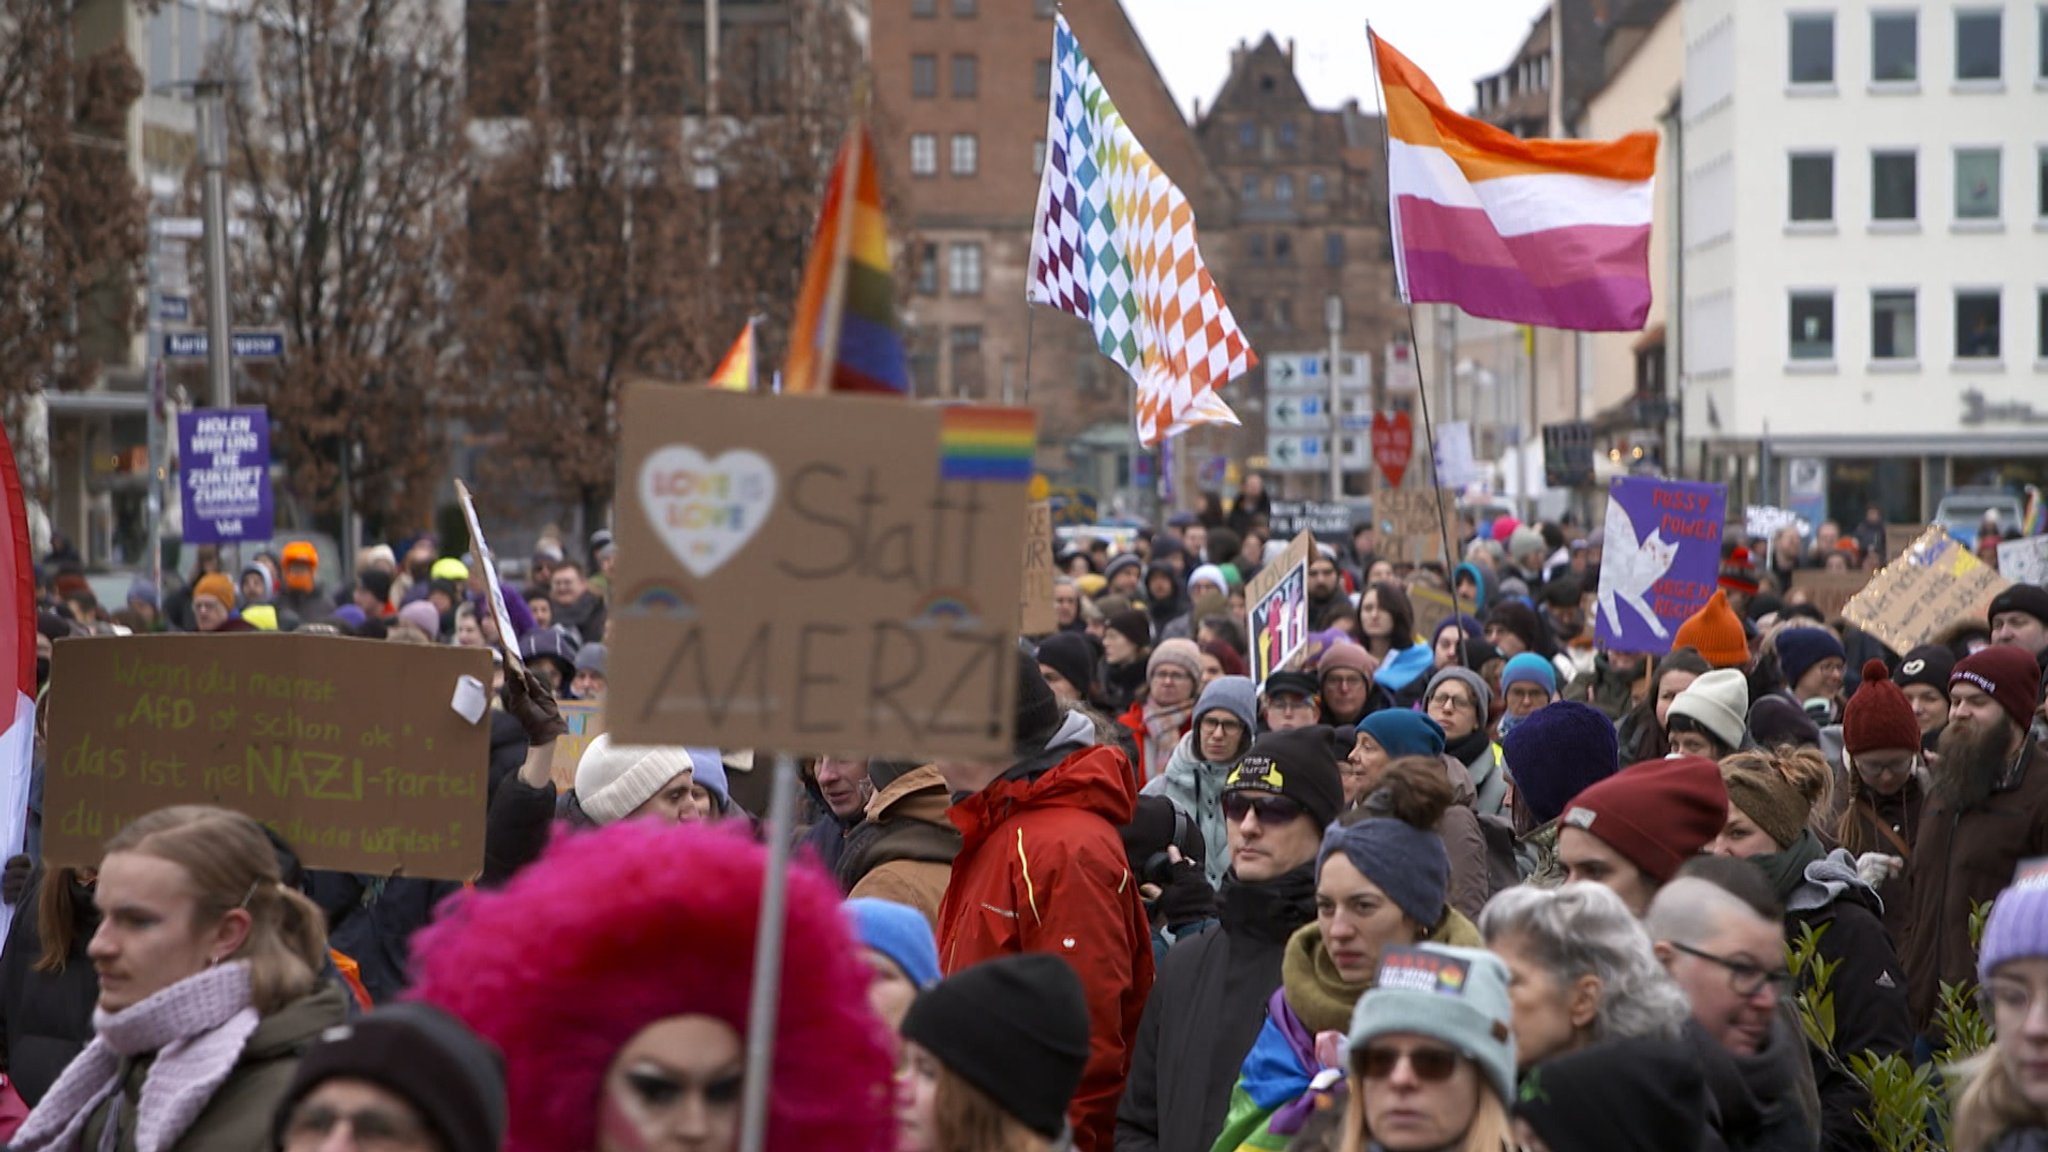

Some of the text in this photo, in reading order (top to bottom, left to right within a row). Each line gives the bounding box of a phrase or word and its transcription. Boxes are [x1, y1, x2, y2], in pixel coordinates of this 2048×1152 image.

[197, 416, 251, 434] HOLEN
[191, 435, 224, 454] WIR
[213, 453, 239, 468] DIE
[189, 467, 263, 488] ZUKUNFT
[652, 468, 730, 498] LOVE
[1653, 488, 1709, 512] PUSSY
[665, 502, 745, 533] LOVE
[775, 461, 990, 590] Statt
[1661, 512, 1717, 540] POWER
[199, 660, 237, 693] du
[637, 620, 1006, 742] MERZ!
[252, 708, 342, 741] schon
[62, 734, 127, 778] das
[139, 751, 188, 788] ist
[61, 800, 102, 837] du
